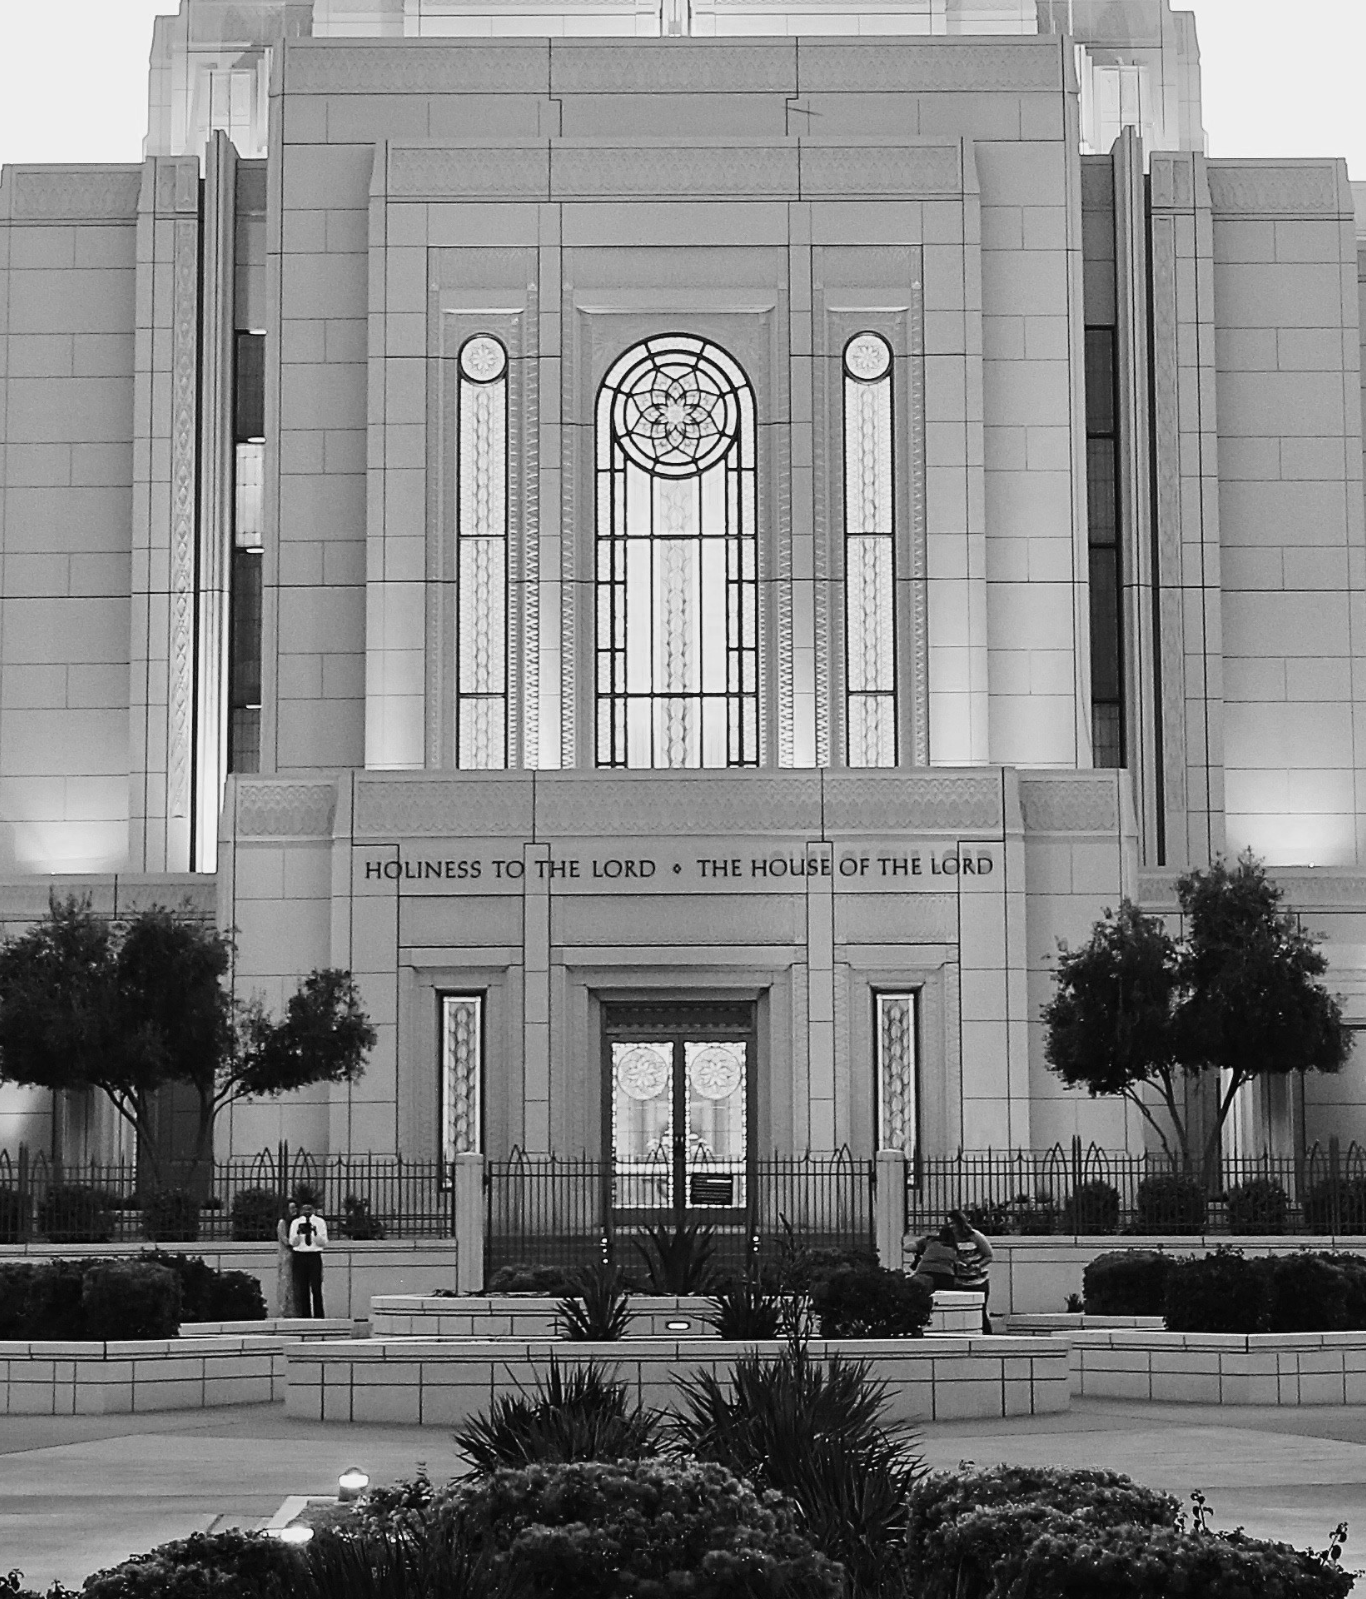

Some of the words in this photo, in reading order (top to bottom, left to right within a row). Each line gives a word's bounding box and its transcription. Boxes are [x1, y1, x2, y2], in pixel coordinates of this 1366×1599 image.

[365, 860, 482, 880] HOLINESS
[491, 860, 525, 879] TO
[535, 859, 580, 879] THE
[592, 859, 656, 878] LORD
[696, 859, 743, 878] THE
[751, 858, 832, 877] HOUSE
[838, 857, 870, 877] OF
[876, 857, 923, 877] THE
[930, 857, 994, 876] LORD
